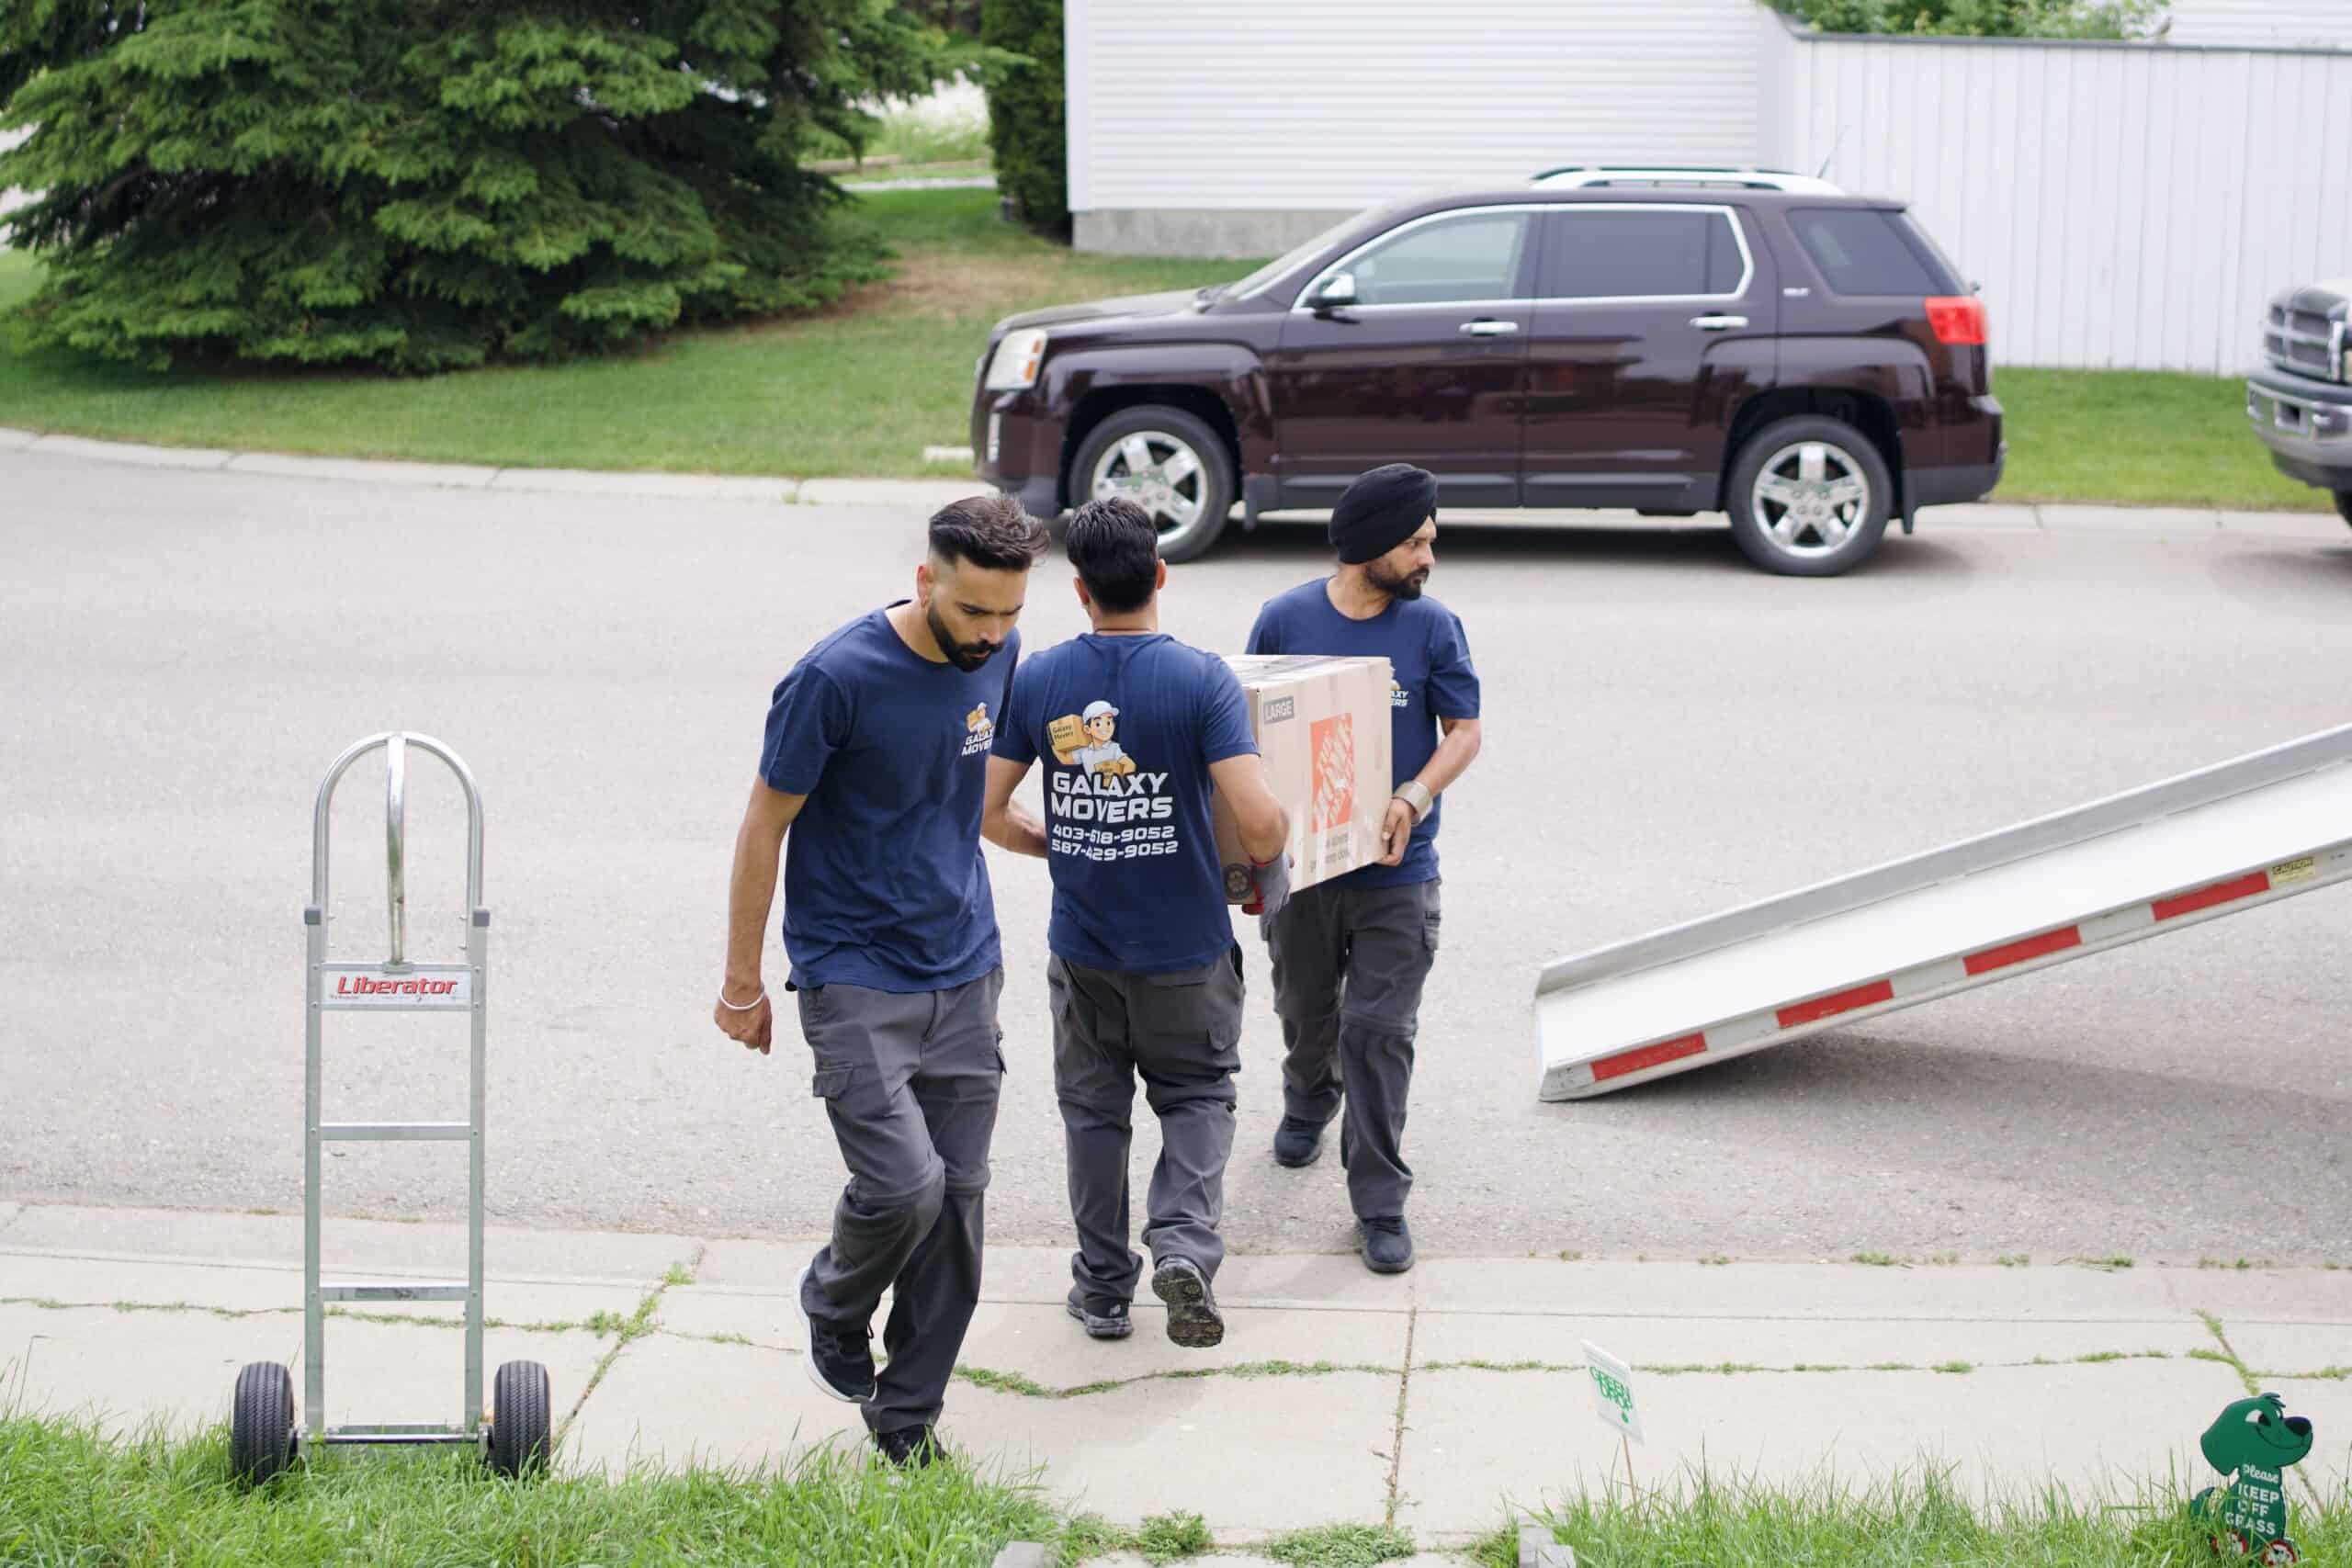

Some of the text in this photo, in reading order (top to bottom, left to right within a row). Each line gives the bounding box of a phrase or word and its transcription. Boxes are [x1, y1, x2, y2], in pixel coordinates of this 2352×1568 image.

[1264, 699, 1293, 720] LARGE
[961, 739, 992, 757] MOVE
[1052, 771, 1169, 797] GALAXY
[1050, 792, 1173, 824] MOVERS
[1051, 838, 1178, 862] 587-429-9052
[337, 975, 458, 995] Liberator
[2242, 1463, 2279, 1483] Please
[2238, 1483, 2279, 1505] KEEP
[2237, 1499, 2269, 1517] OFF
[2225, 1512, 2277, 1535] GRASS
